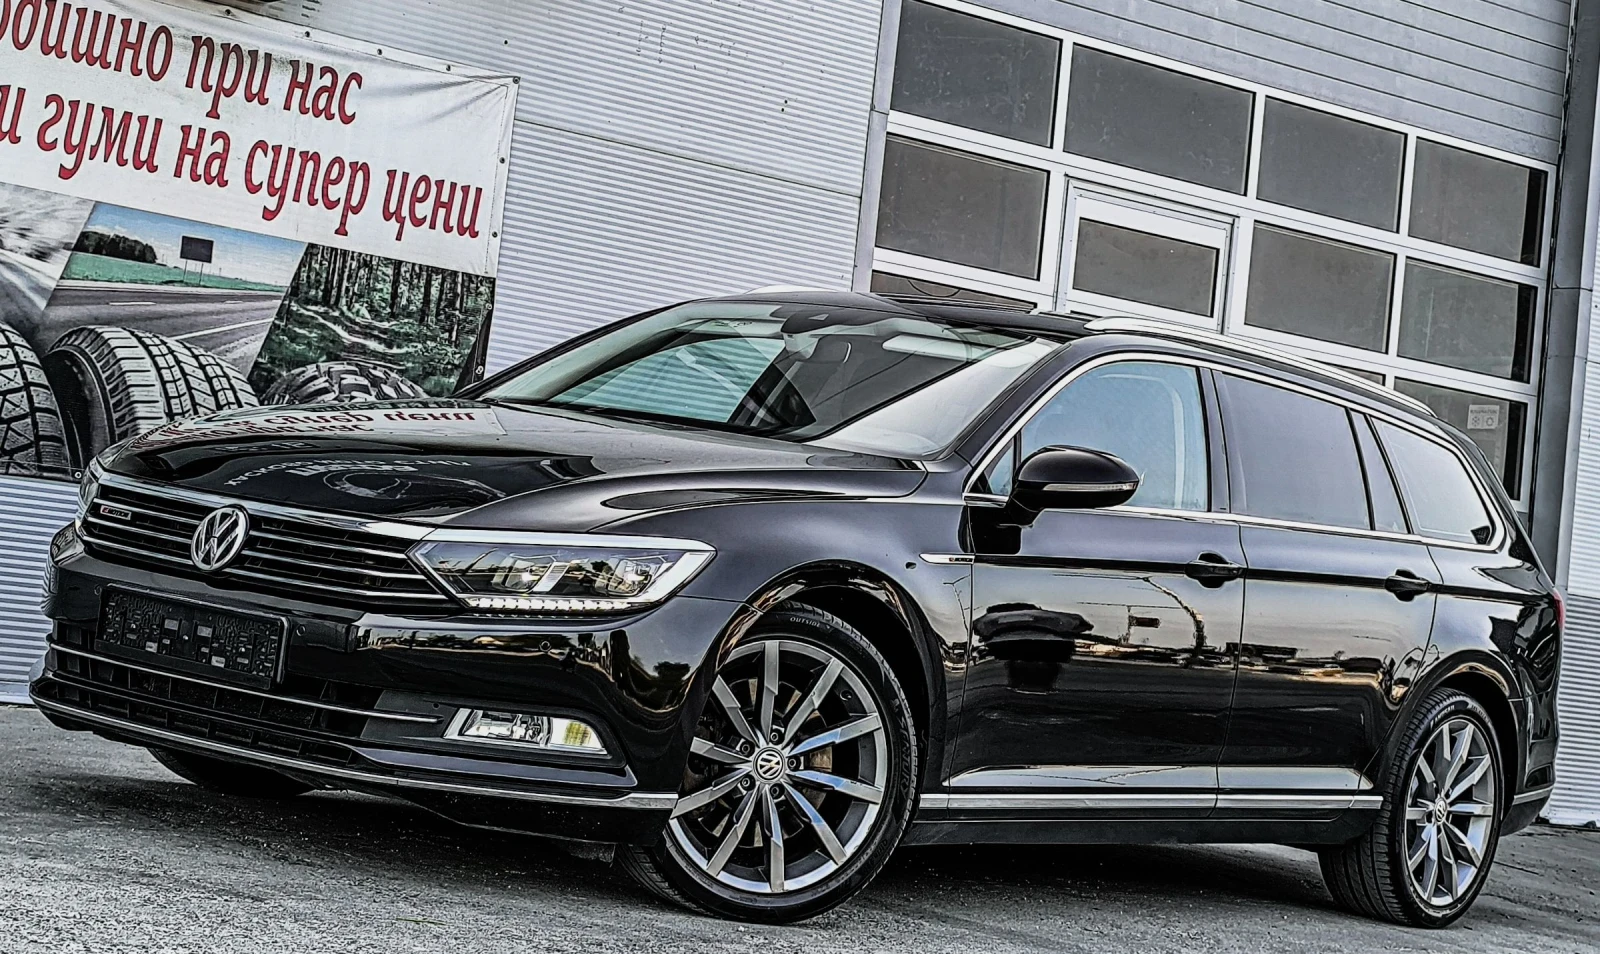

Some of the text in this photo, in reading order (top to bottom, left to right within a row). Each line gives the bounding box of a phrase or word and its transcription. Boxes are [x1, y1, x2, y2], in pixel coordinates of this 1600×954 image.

[185, 35, 272, 120] при
[283, 59, 363, 125] нас
[37, 93, 163, 180] гуми
[173, 125, 231, 188] на
[244, 139, 371, 237] супер
[382, 169, 483, 242] цени
